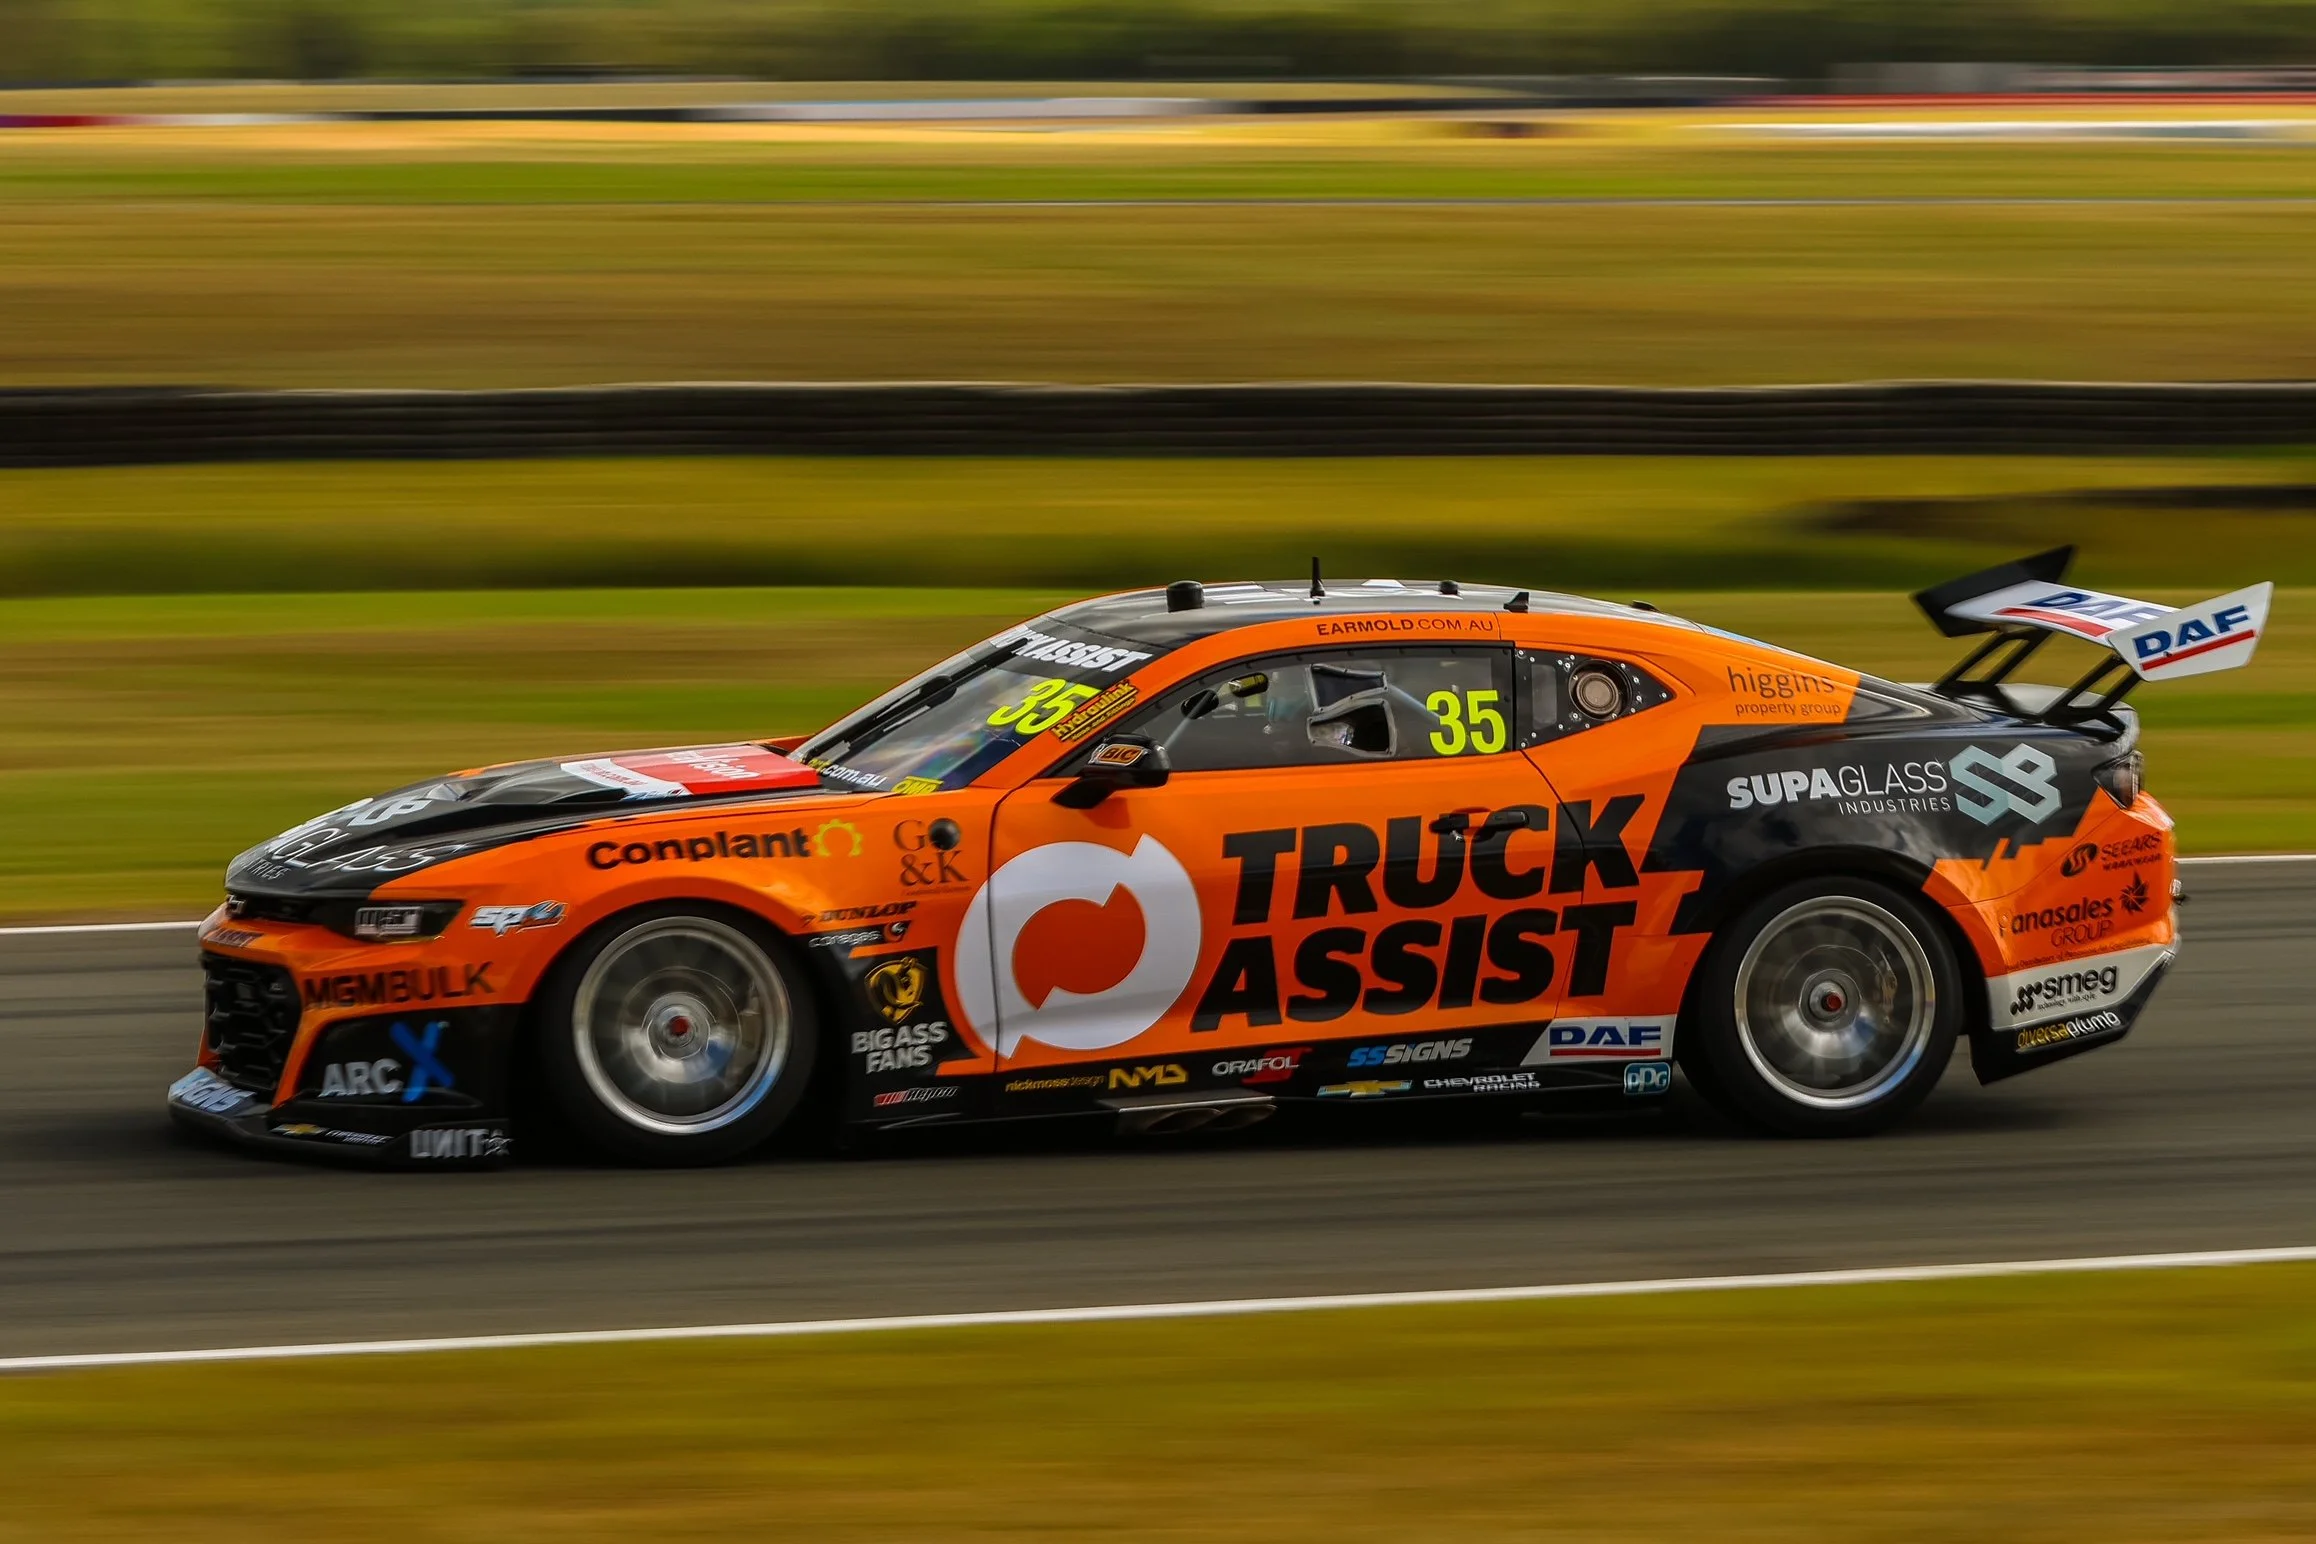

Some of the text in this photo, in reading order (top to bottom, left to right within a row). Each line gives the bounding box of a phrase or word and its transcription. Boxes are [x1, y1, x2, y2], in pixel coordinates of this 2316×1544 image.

[1317, 618, 1494, 636] EARMOLD.COM.AU
[2132, 605, 2252, 659] DAF
[1026, 639, 1153, 673] ASSIST
[1727, 665, 1836, 699] higgins
[986, 678, 1102, 736] 35
[1051, 682, 1138, 738] Hydraulink
[1425, 689, 1506, 756] 35
[1734, 701, 1842, 717] property group
[1726, 761, 1950, 811] SUPAGLASS
[1838, 796, 1951, 815] INDUSTRIES
[586, 826, 813, 870] Conplant
[1222, 793, 1646, 926] TRUCK
[820, 901, 917, 922] DUNLOP
[2051, 919, 2115, 947] GROUP
[1188, 901, 1637, 1032] ASSIST
[2042, 965, 2118, 999] smeg
[851, 1022, 949, 1054] BIG ASS
[1550, 1026, 1661, 1046] DAF
[2017, 1010, 2121, 1049] diversaplumb
[865, 1046, 933, 1074] FANS
[1211, 1056, 1300, 1077] ORAFOL
[1347, 1038, 1474, 1068] SSSIGNS
[319, 1058, 403, 1097] ARC
[1108, 1064, 1189, 1089] NMD
[1423, 1072, 1536, 1089] CHEVROLET
[410, 1128, 490, 1159] UNIT
